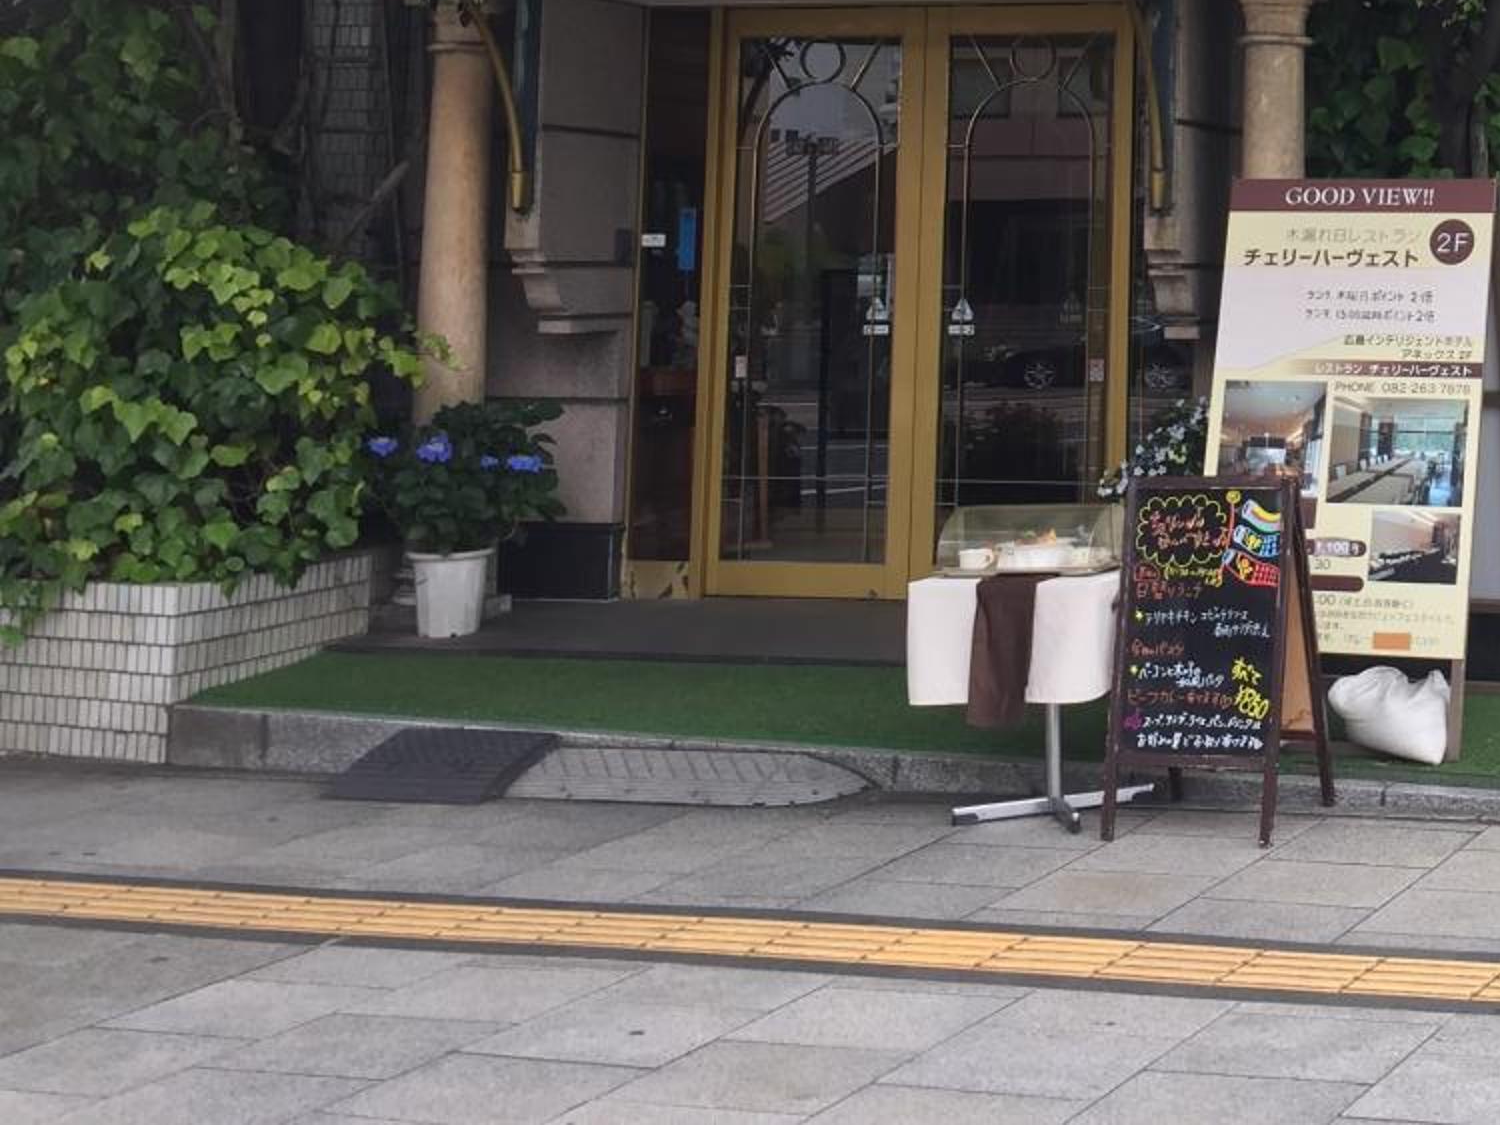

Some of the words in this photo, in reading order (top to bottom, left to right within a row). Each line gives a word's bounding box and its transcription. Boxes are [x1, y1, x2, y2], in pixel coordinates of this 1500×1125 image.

[1285, 187, 1355, 206] GOOD
[1361, 187, 1435, 206] VIEW!!
[1286, 227, 1420, 244] 木漏れ日レストラン
[1436, 232, 1470, 253] 2F
[1243, 249, 1420, 268] チェリーハーヴェスト
[1368, 363, 1473, 377] チェリーハーヴェスト
[1334, 381, 1376, 394] PHONE
